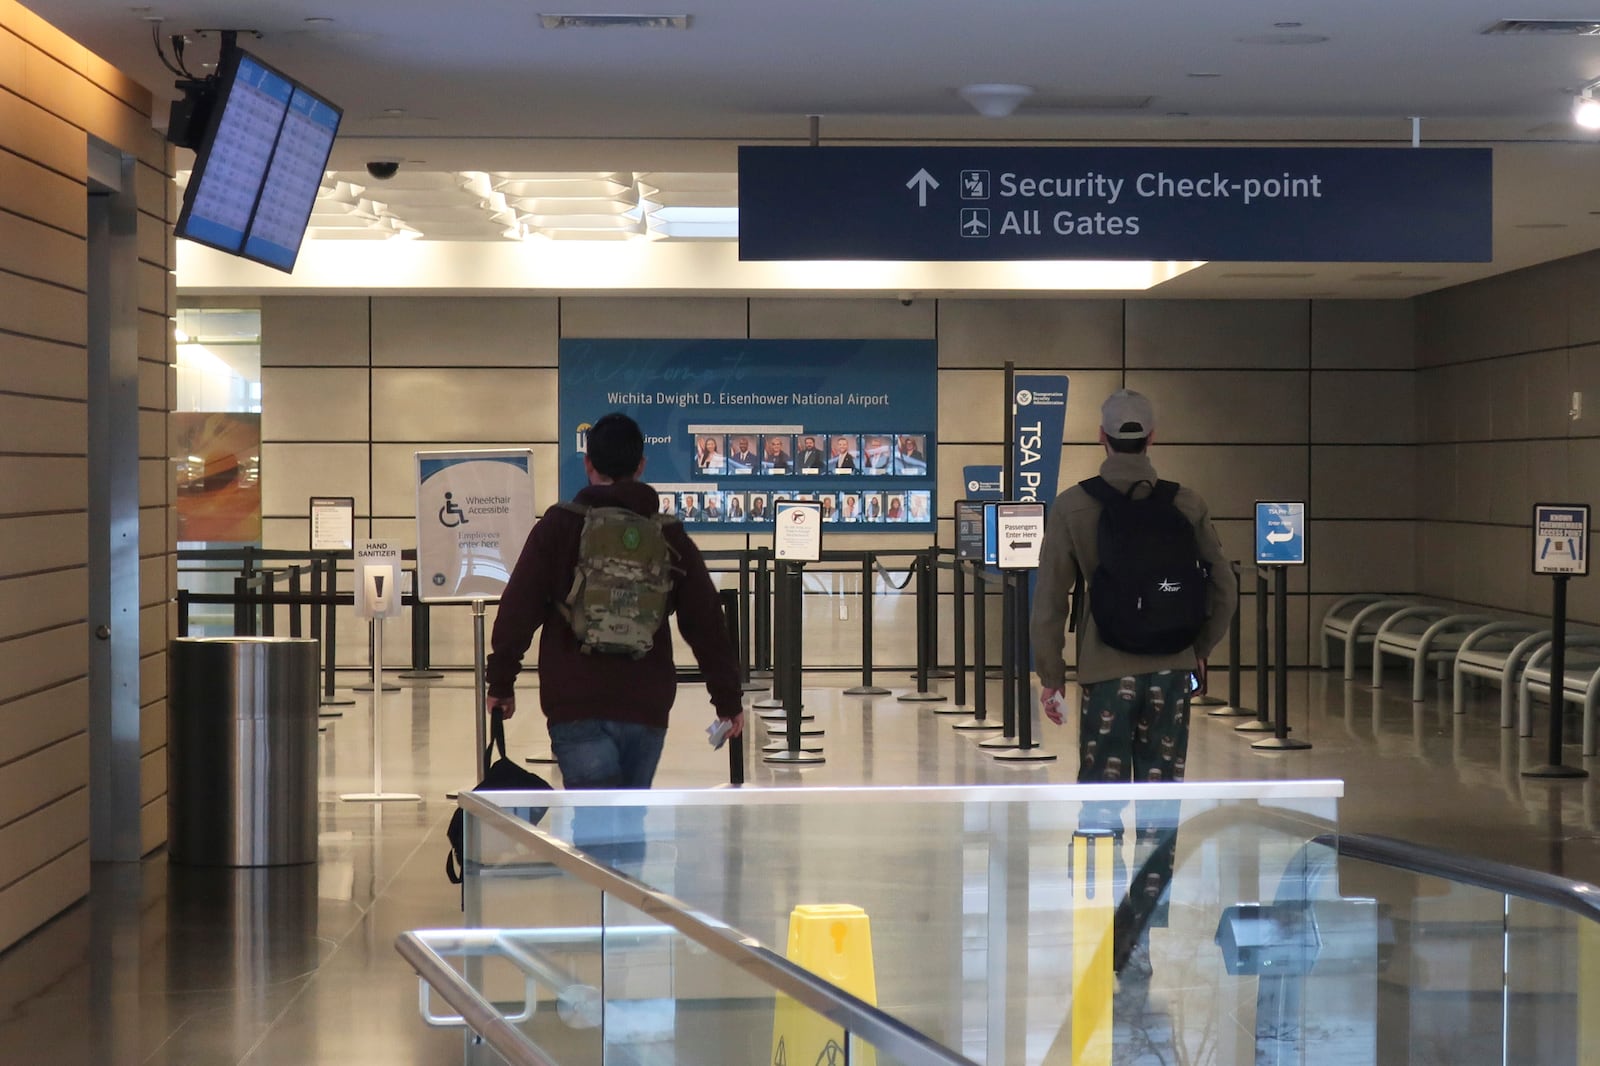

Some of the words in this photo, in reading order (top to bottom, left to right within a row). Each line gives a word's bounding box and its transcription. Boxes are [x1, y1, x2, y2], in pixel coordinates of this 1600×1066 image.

[1000, 172, 1124, 204] Security
[1136, 172, 1322, 204] Check-point
[1000, 210, 1041, 235] All
[1053, 211, 1140, 235] Gates
[607, 392, 652, 404] Wichita
[656, 392, 700, 407] Dwight
[703, 393, 716, 404] D.
[719, 393, 788, 405] Eisenhower
[792, 393, 843, 405] National
[847, 393, 889, 408] Airport
[643, 433, 672, 445] irport
[1020, 421, 1041, 466] TSA
[465, 496, 511, 505] Wheelchair
[468, 505, 510, 514] Accessible
[1005, 524, 1038, 532] Passengers
[458, 531, 500, 541] Employees
[458, 540, 479, 549] enter
[481, 540, 499, 548] here
